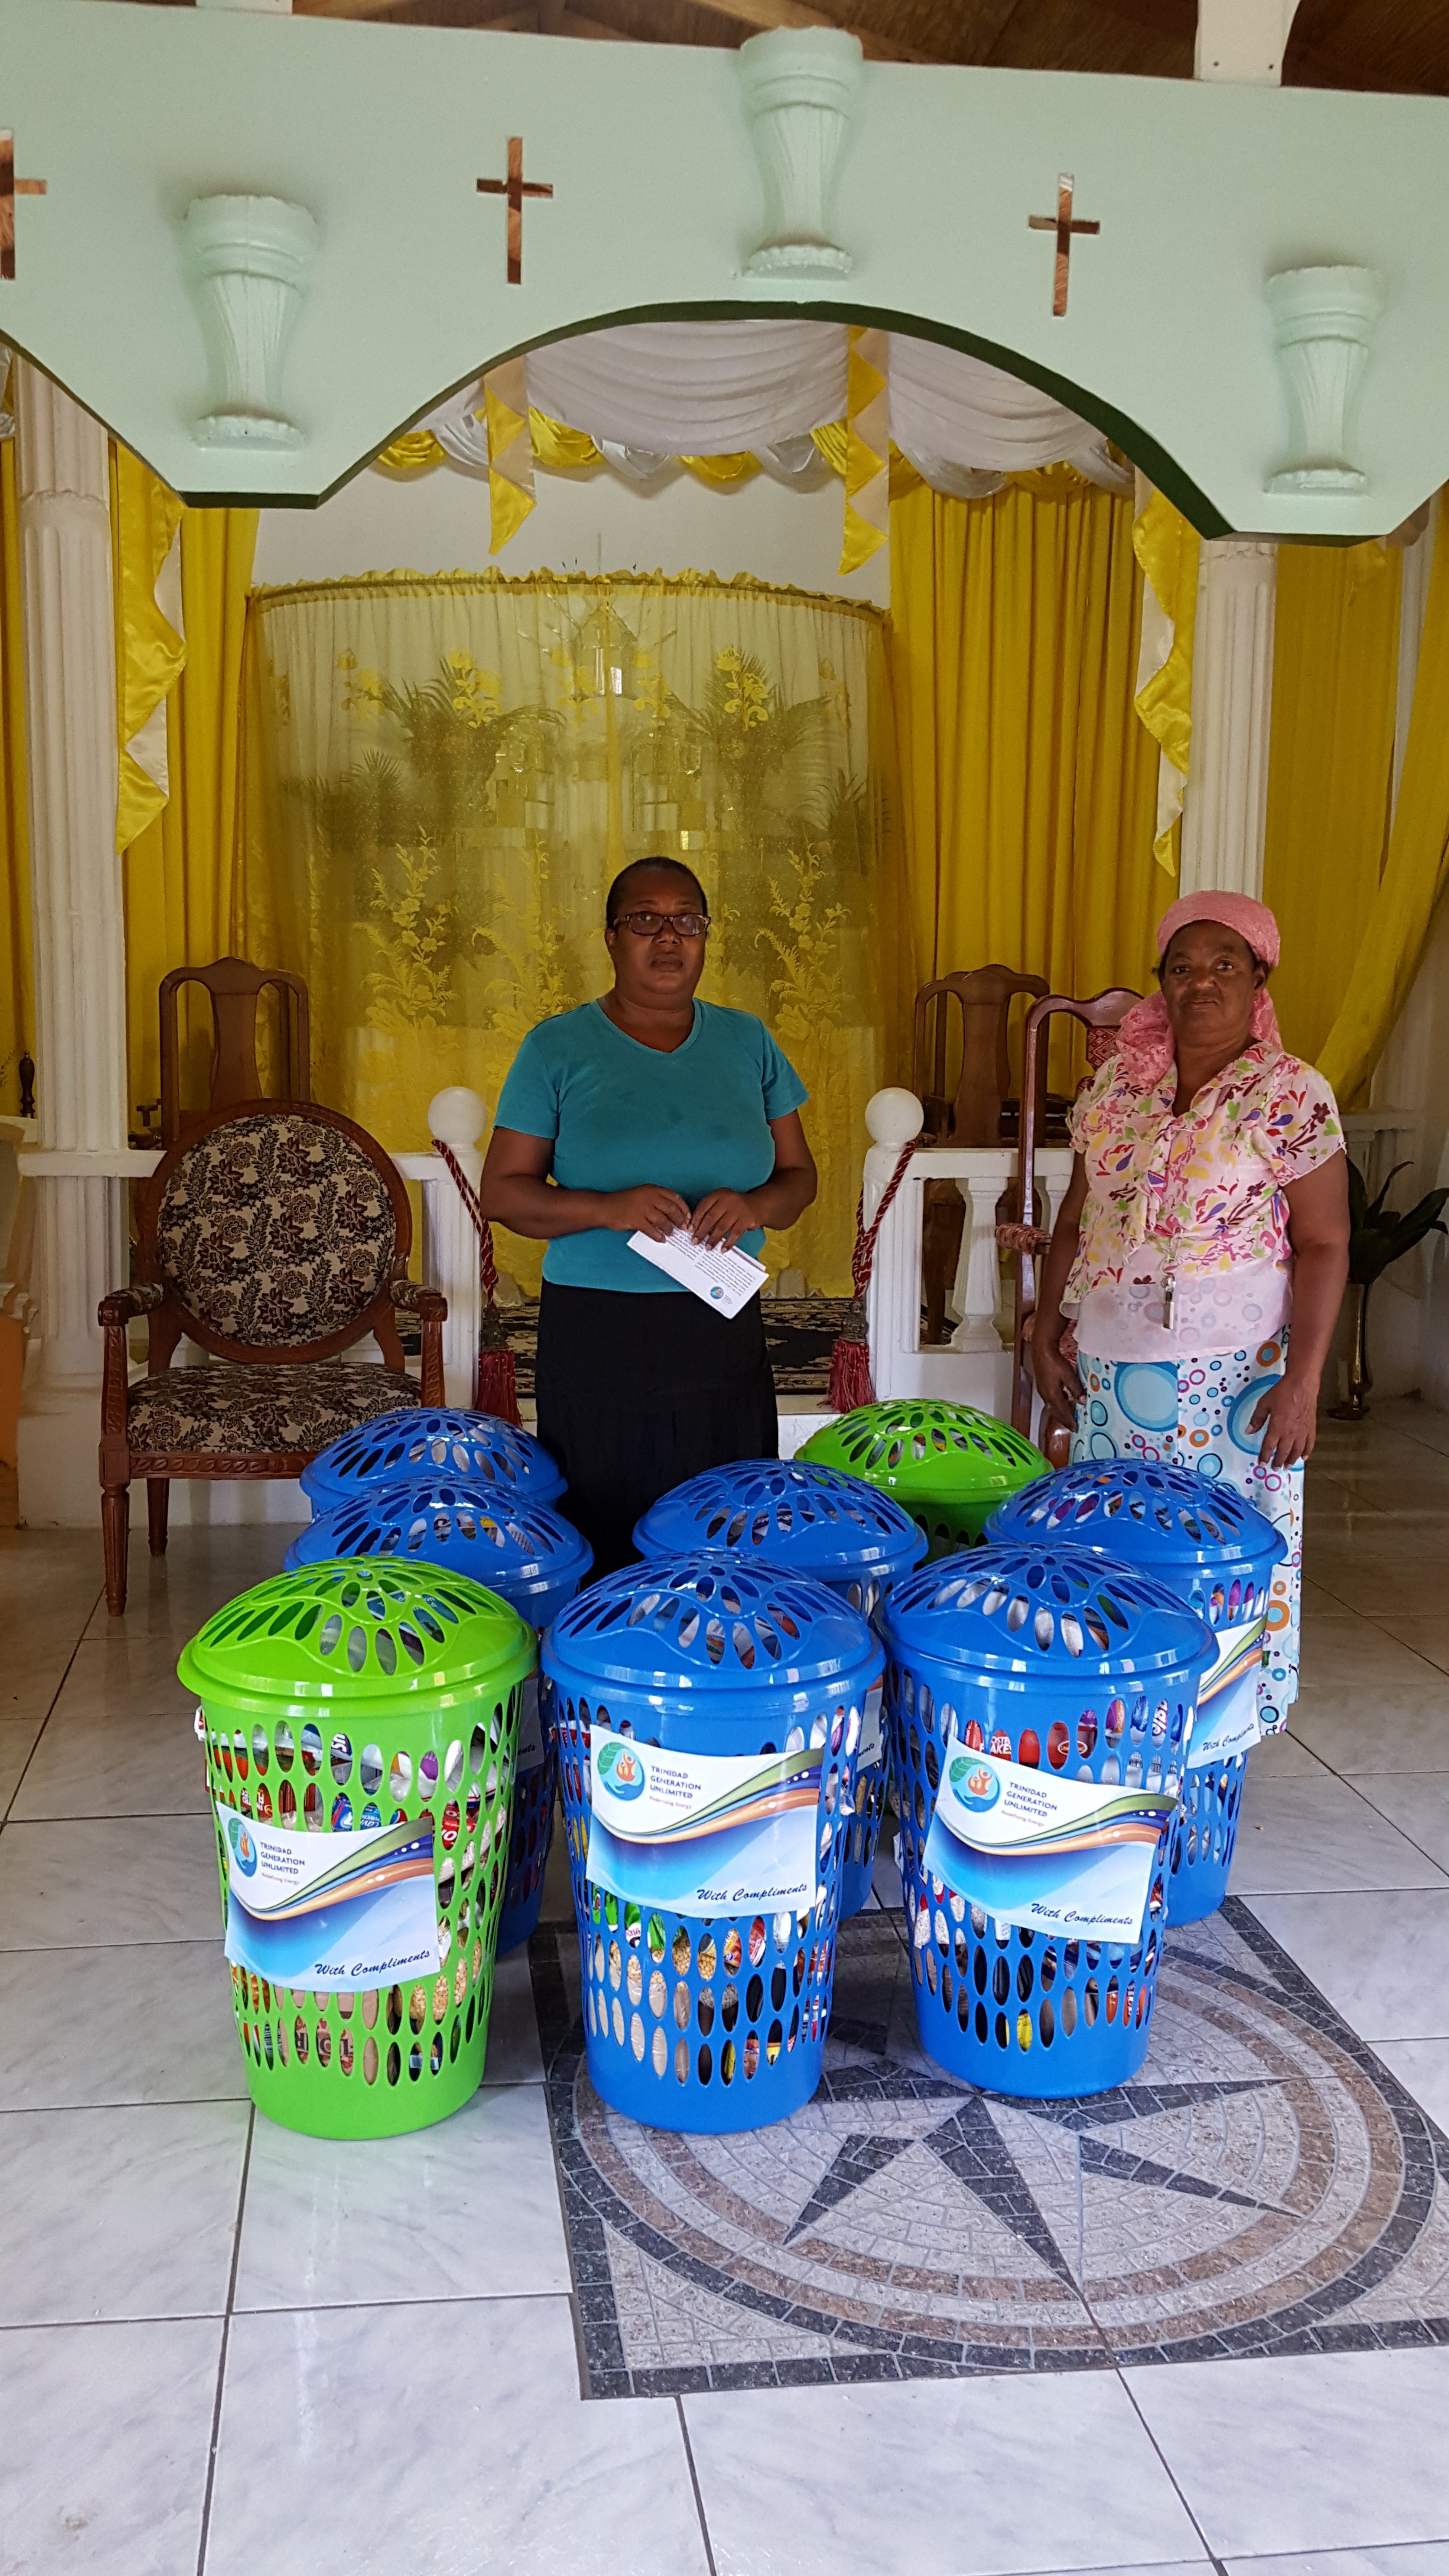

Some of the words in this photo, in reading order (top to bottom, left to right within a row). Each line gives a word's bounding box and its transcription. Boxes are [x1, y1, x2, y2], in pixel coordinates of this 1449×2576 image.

[651, 1765, 689, 1779] TRINIDAD
[650, 1775, 701, 1790] GENERATION
[1010, 1782, 1047, 1799] TRINIDAD
[650, 1784, 693, 1799] UNLIMITED
[1004, 1799, 1047, 1817] UNLIMITED
[1007, 1790, 1058, 1811] GENERATION
[260, 1842, 292, 1855] TRINIDAD
[261, 1852, 305, 1866] GENERATION
[261, 1861, 299, 1874] UNLIMITED
[697, 1889, 727, 1900] With
[732, 1884, 807, 1901] Compliments
[1031, 1903, 1061, 1918] With
[1064, 1911, 1133, 1925] Compliments
[315, 1964, 345, 1975] With
[351, 1950, 431, 1976] Compliments
